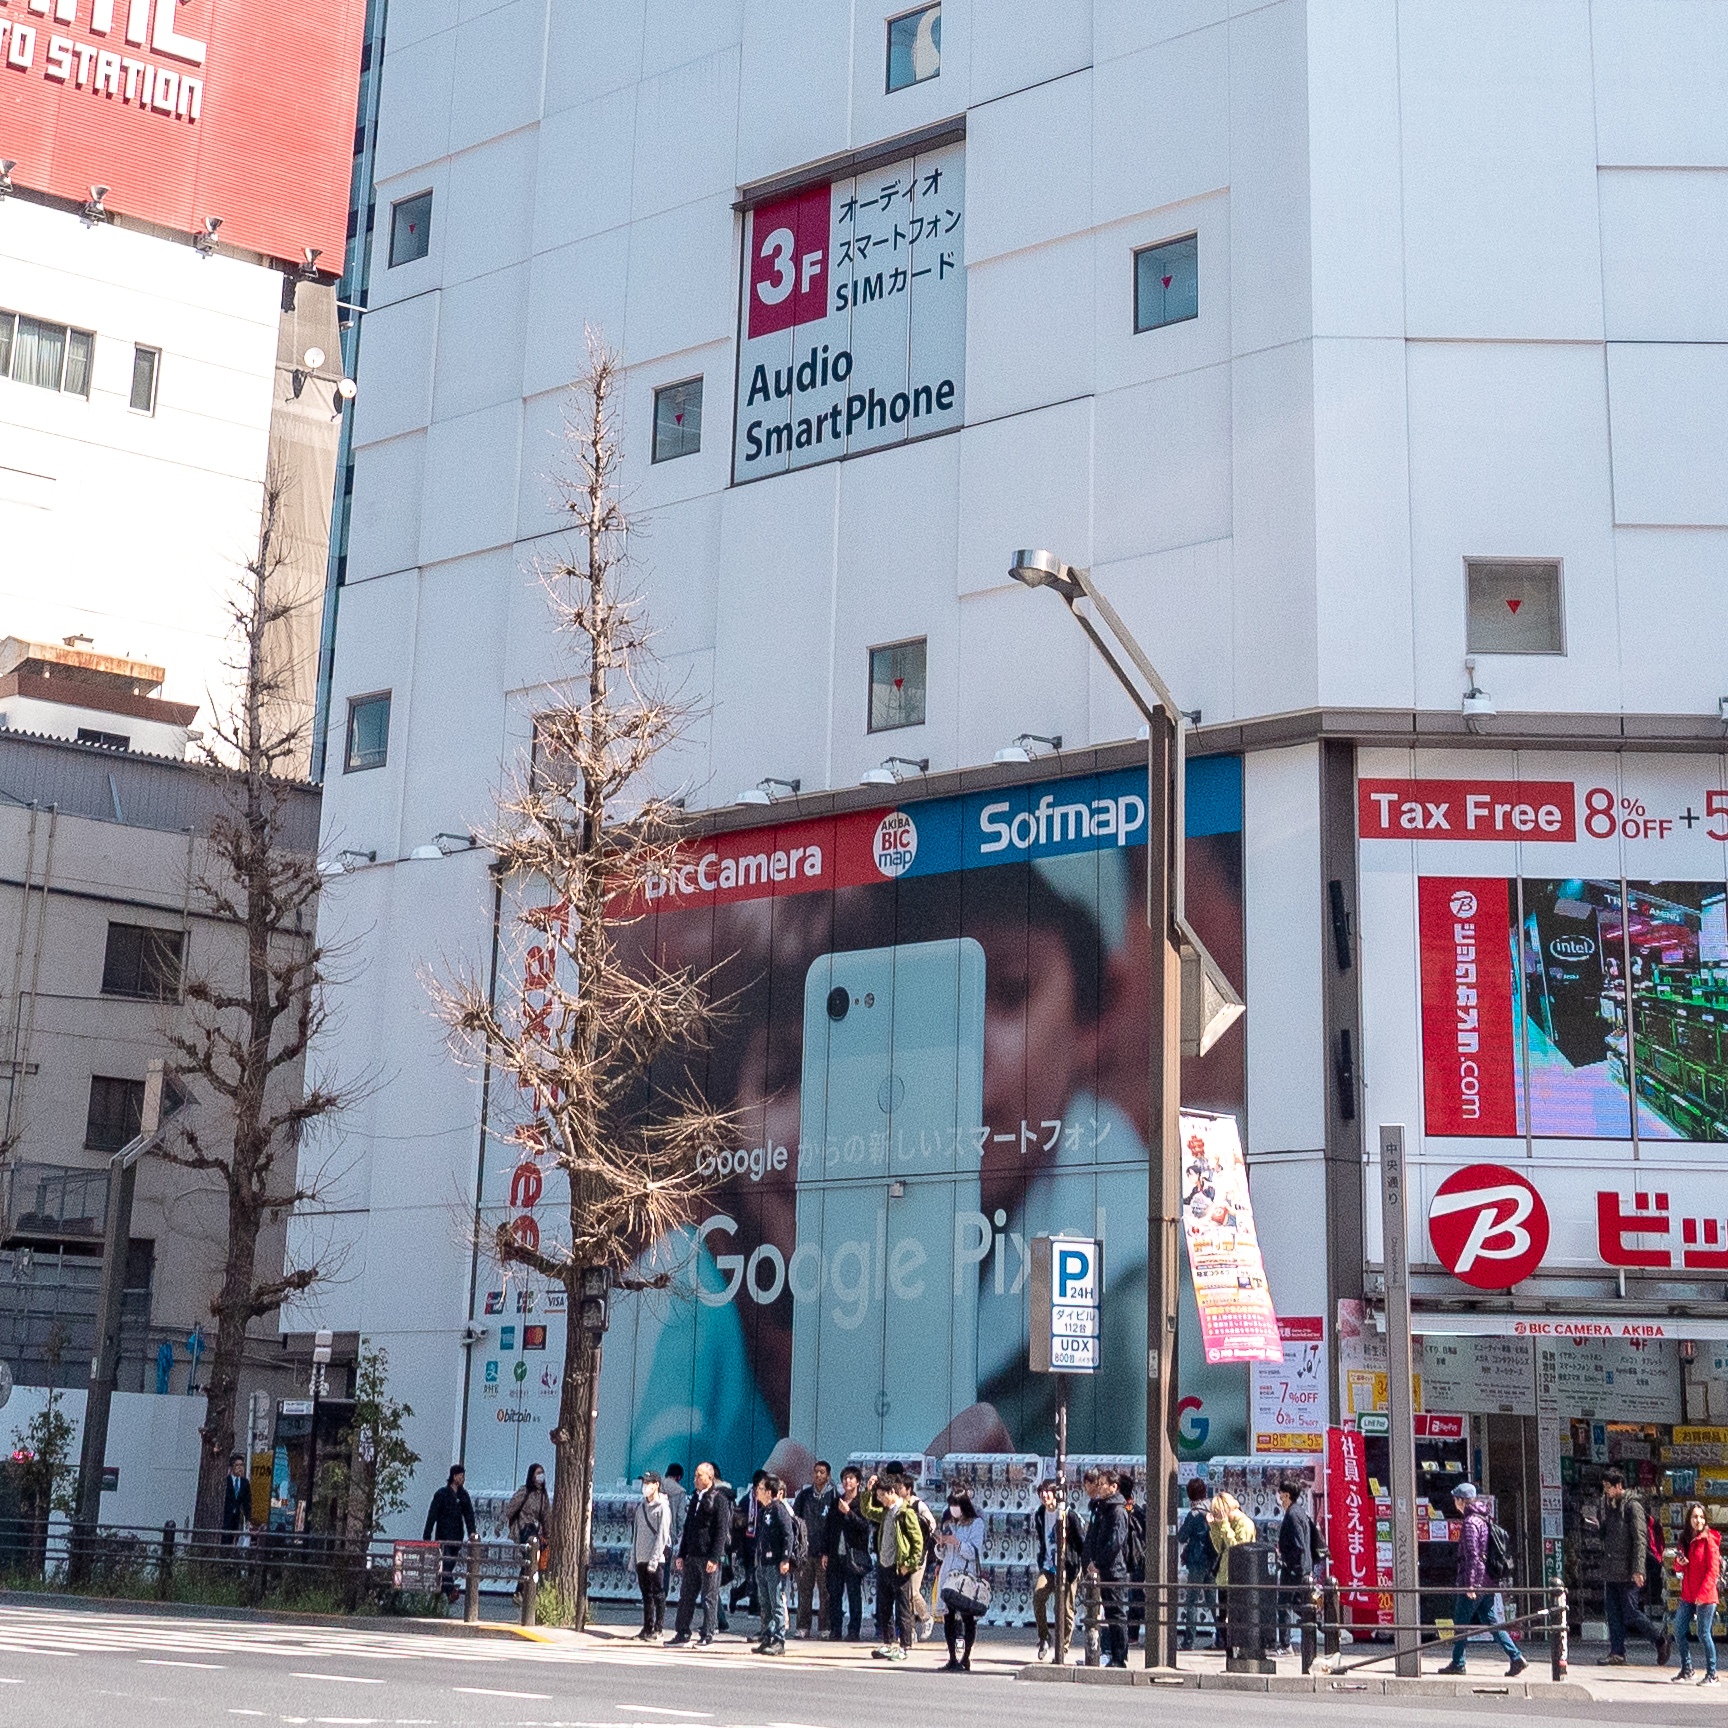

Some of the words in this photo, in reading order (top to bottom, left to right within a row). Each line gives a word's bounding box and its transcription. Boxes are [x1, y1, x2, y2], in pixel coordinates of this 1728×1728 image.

[45, 34, 205, 123] STATION
[838, 168, 943, 224] オーディオ
[836, 209, 962, 268] スマートフォン
[757, 227, 823, 306] 3F
[835, 252, 956, 312] SIMカード
[747, 344, 853, 407] Audio
[745, 379, 955, 462] SmartPhone
[880, 817, 911, 833] AKIBA
[979, 794, 1145, 855] Sofmap
[1370, 792, 1451, 830] Tax
[1465, 794, 1562, 832] Free
[1621, 818, 1673, 839] OFF
[878, 848, 913, 874] map
[881, 829, 911, 853] BIC
[798, 1118, 1112, 1167] からの新しいスマートフォン
[1385, 1143, 1399, 1206] 中央通り
[694, 1208, 928, 1330] Google
[1059, 1250, 1089, 1298] P
[1070, 1287, 1095, 1300] 24H
[548, 1295, 565, 1307] VISA
[1056, 1309, 1096, 1321] ダイビル
[1061, 1338, 1090, 1352] UDX
[1529, 1323, 1551, 1334] BIC
[1554, 1324, 1613, 1336] CAMERA
[1622, 1325, 1664, 1337] AKIBA
[1339, 1433, 1371, 1603] 社員ふえました
